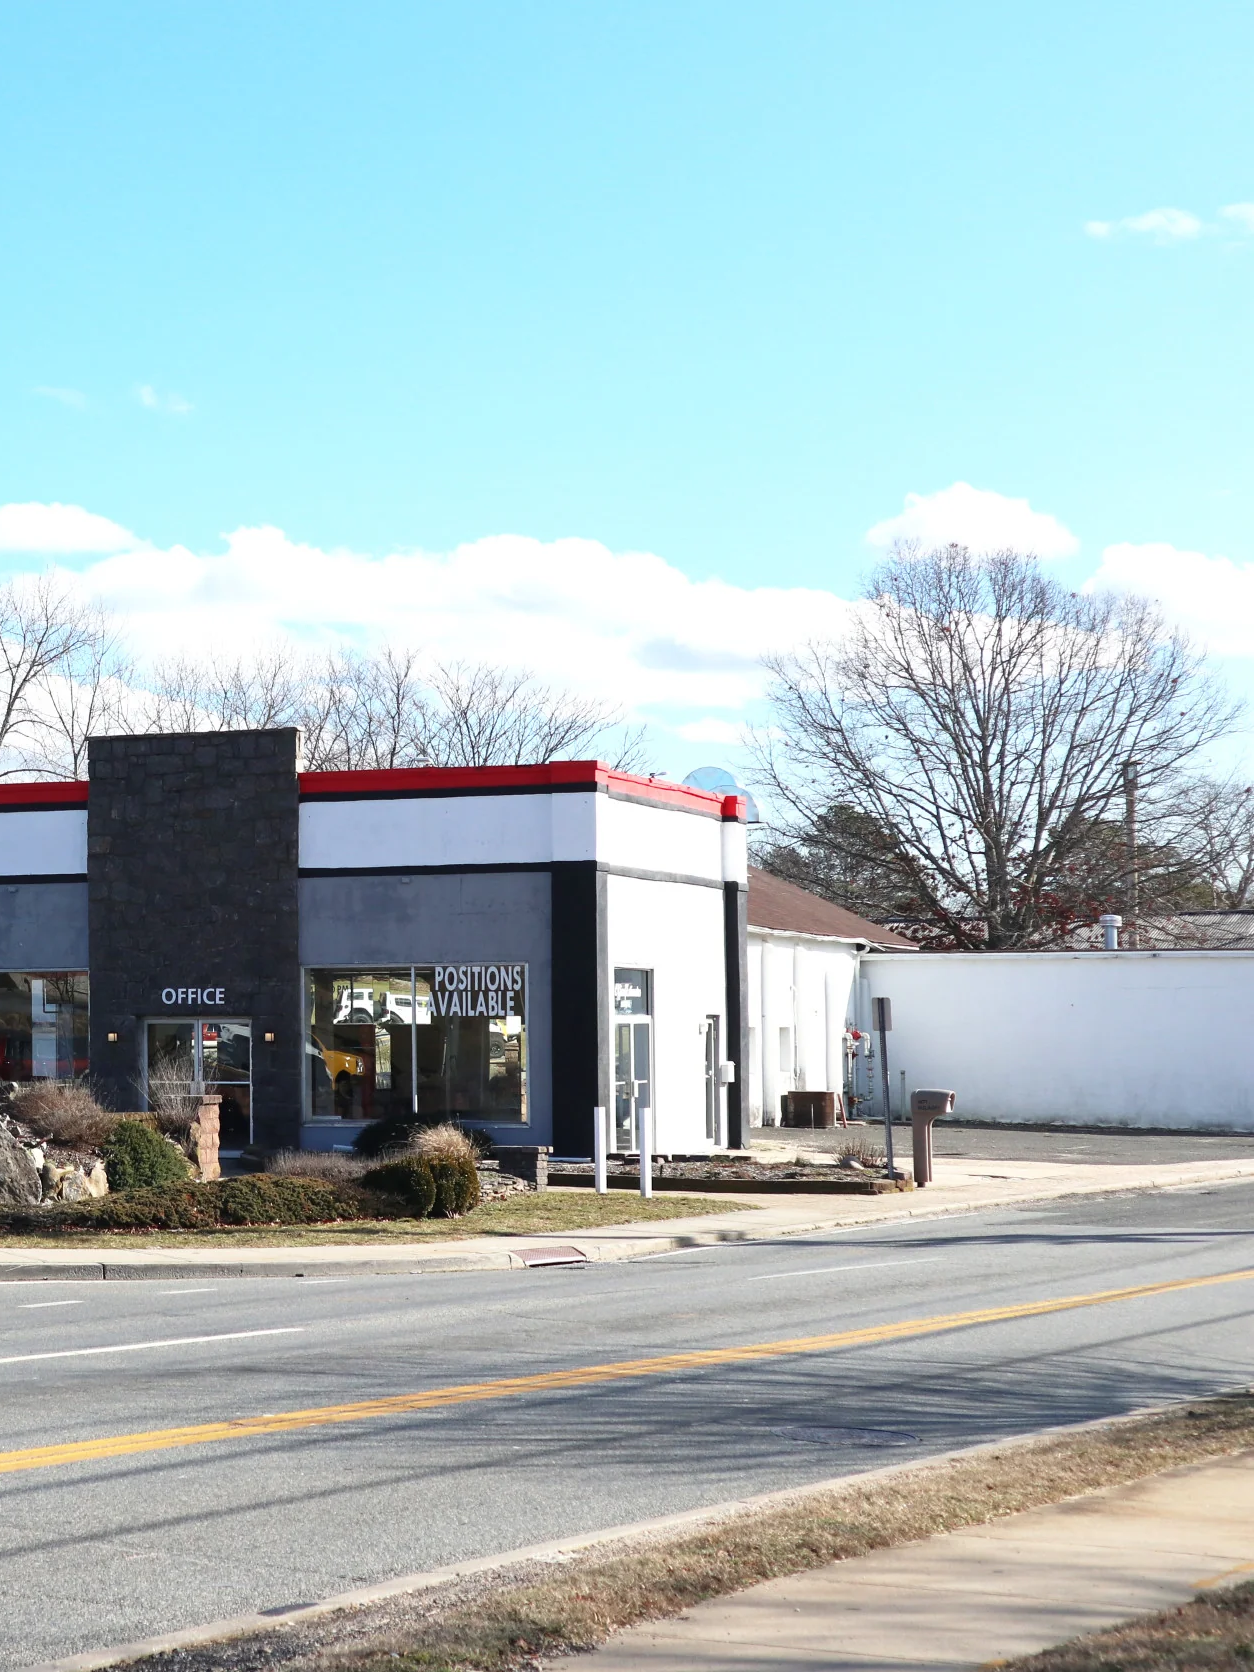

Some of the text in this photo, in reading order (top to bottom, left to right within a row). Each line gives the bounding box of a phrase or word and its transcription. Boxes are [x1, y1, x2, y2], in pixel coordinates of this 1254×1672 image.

[434, 966, 522, 991] POSITIONS
[161, 988, 225, 1005] OFFICE
[426, 991, 515, 1016] AVAILABLE
